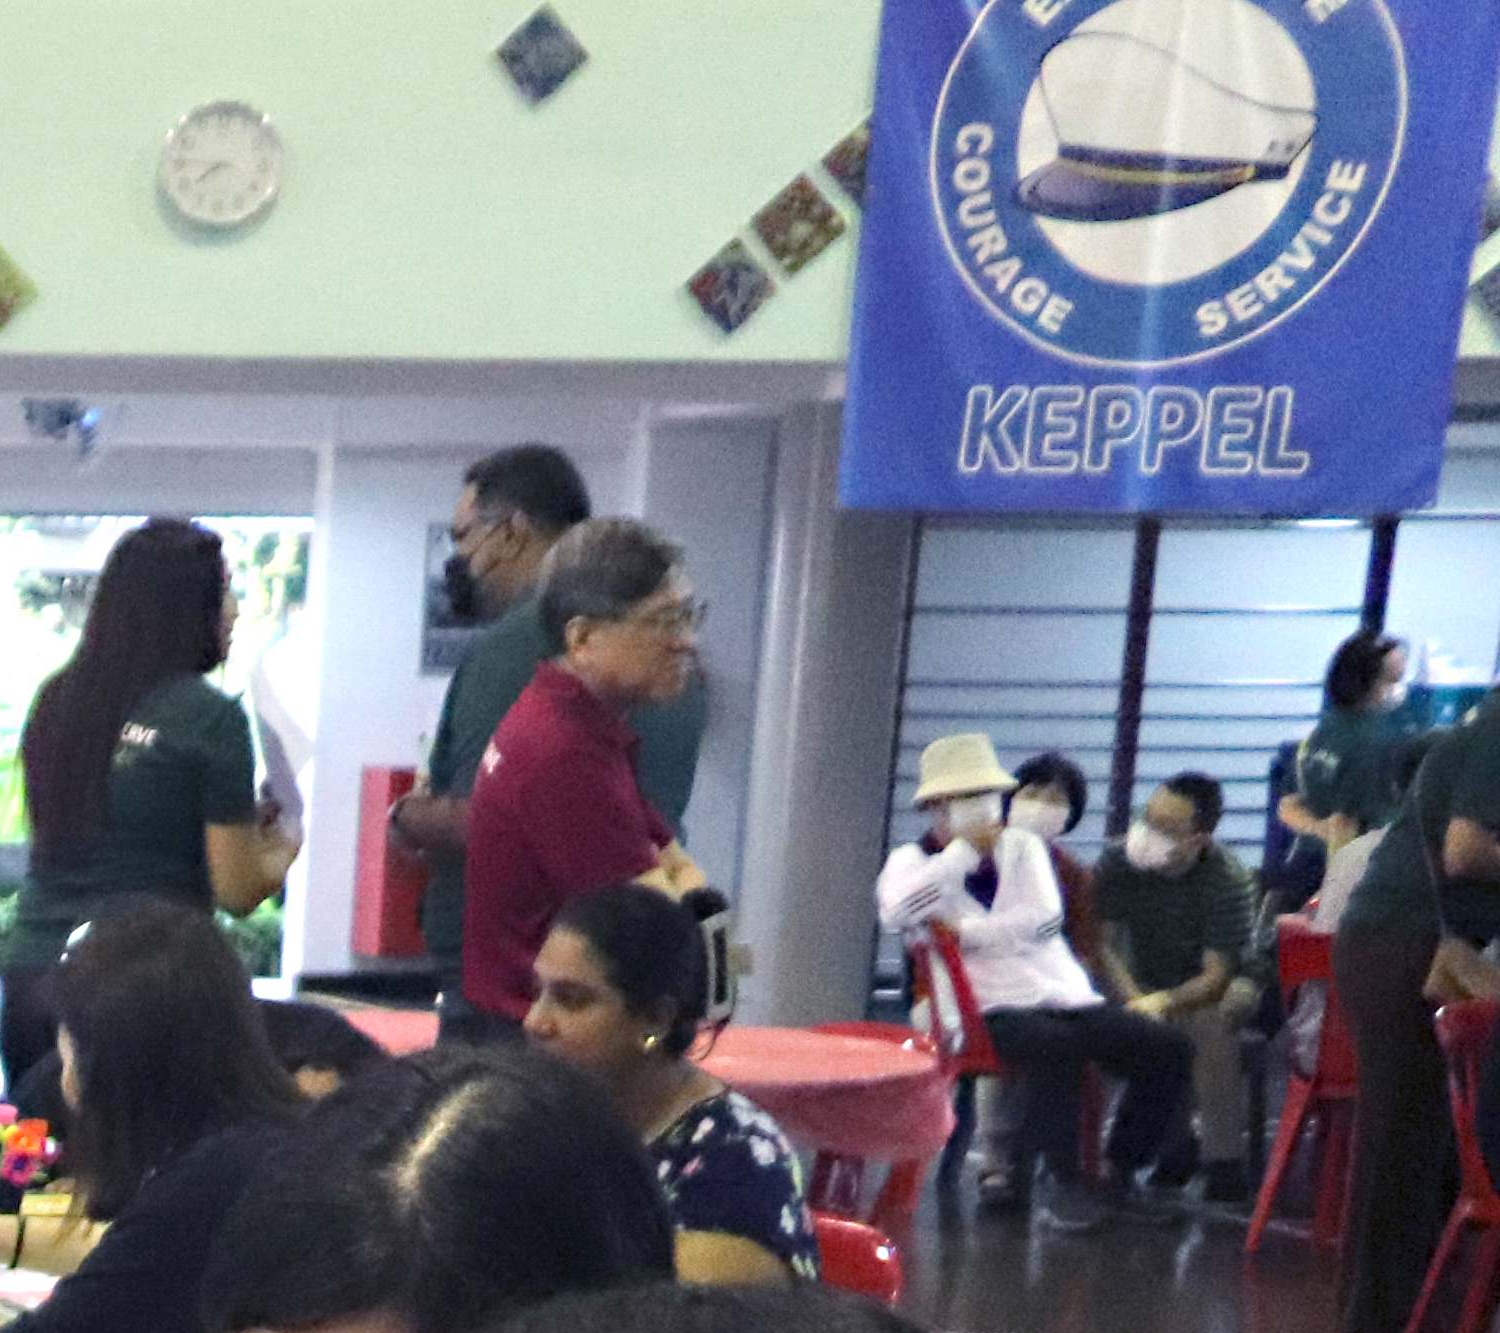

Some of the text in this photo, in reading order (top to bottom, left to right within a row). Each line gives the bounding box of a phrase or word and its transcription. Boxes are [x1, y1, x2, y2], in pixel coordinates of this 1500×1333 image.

[954, 122, 1074, 335] COURAGE
[1194, 159, 1368, 338] SERVICE
[957, 384, 1311, 477] KEPPEL
